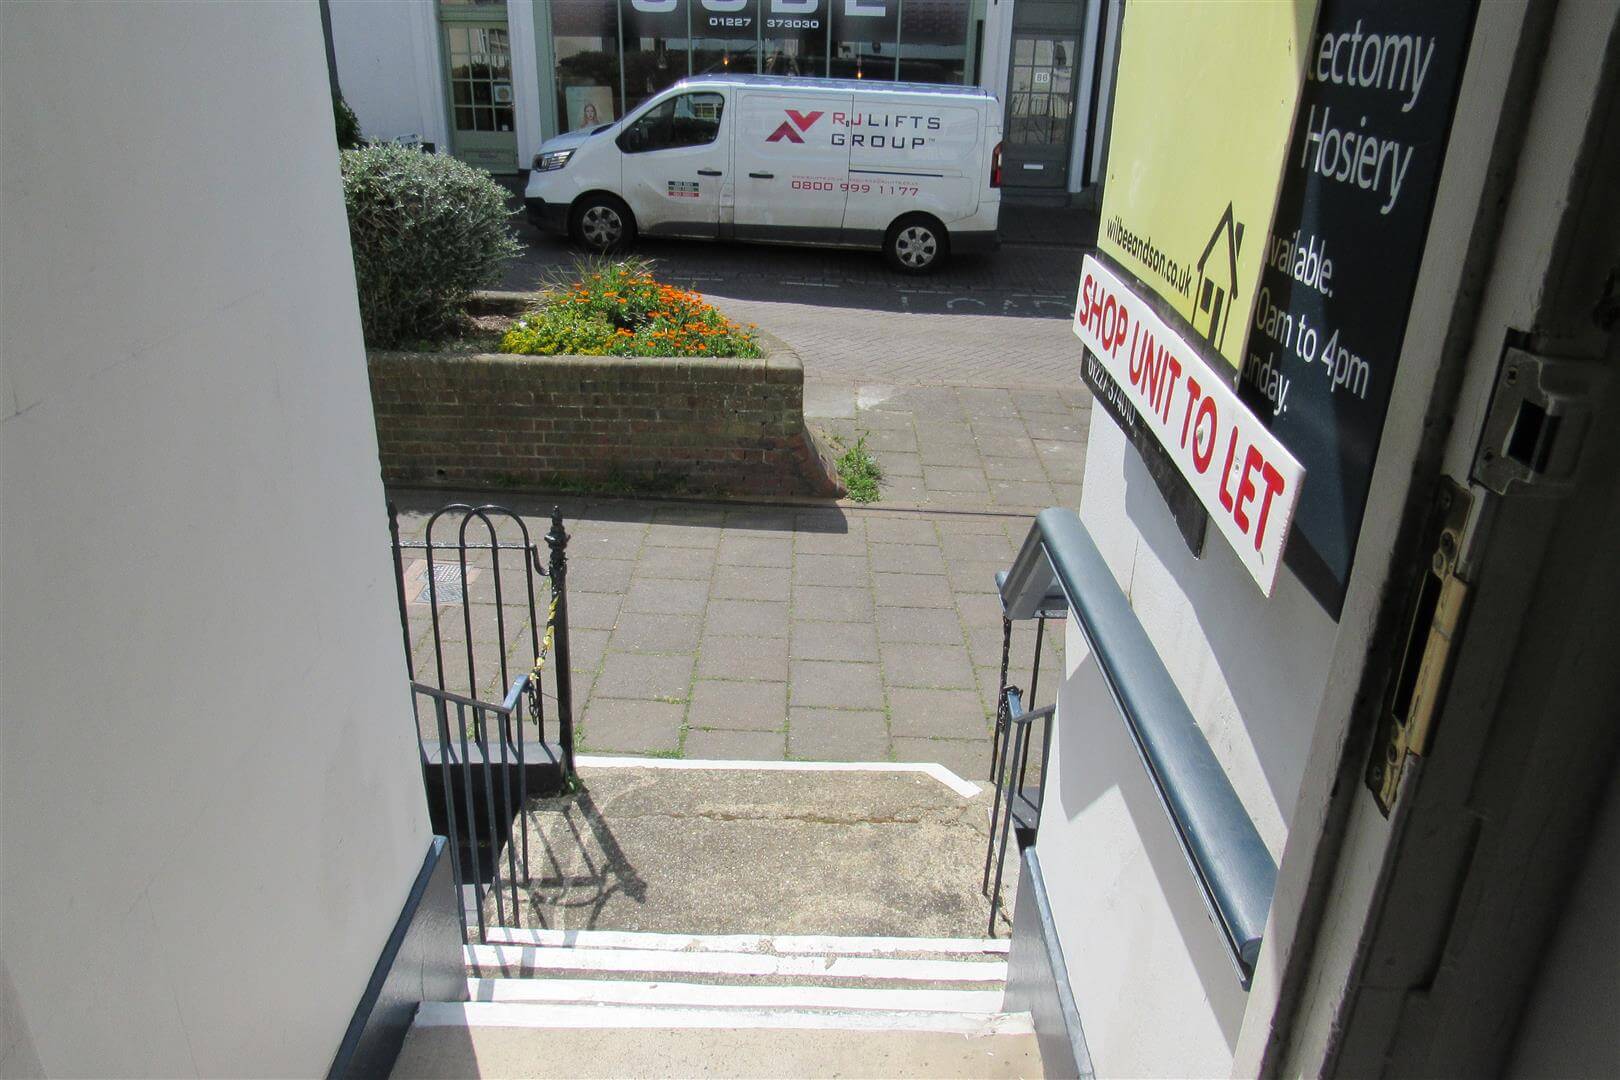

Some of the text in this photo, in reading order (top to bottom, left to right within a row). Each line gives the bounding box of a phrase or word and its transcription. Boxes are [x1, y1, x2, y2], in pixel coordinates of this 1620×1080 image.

[709, 17, 819, 29] 01227 373030
[831, 133, 925, 149] GROUP
[1300, 104, 1414, 215] Hosiery
[791, 180, 919, 196] 0800 999 1177
[1106, 215, 1192, 300] wilbeeandson.co.uk
[1268, 229, 1334, 298] vailable.
[1255, 287, 1370, 400] 0am to 4pm
[1079, 273, 1285, 552] SHOP UNIT TO LET
